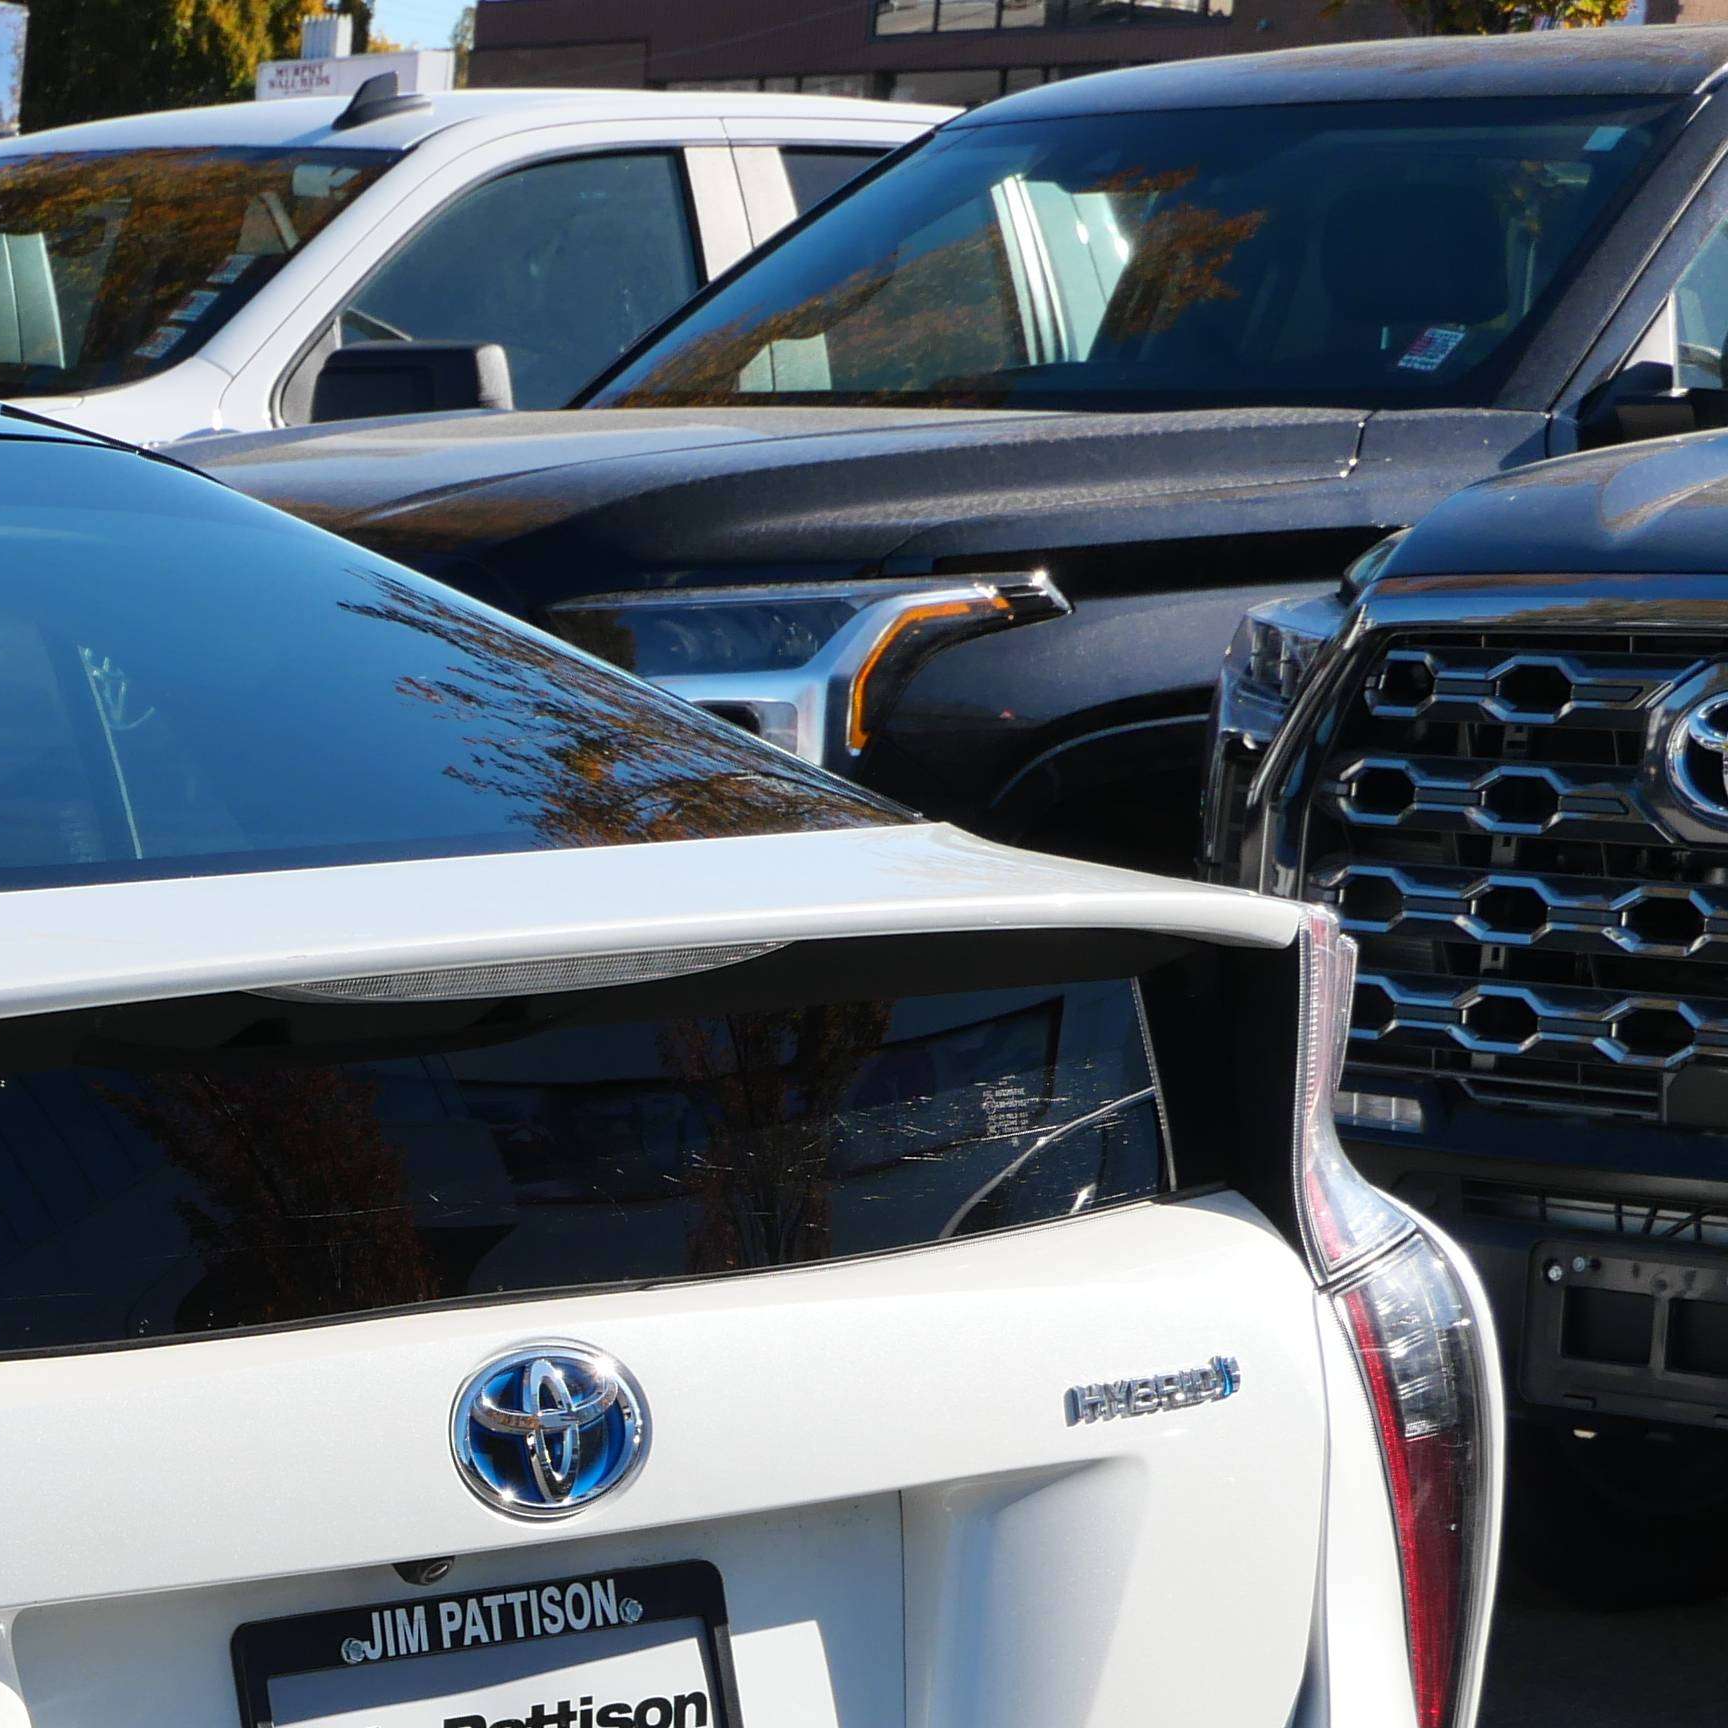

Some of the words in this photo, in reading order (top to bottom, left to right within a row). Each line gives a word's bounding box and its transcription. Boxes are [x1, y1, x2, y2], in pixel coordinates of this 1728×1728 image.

[1064, 1366, 1221, 1428] HYBRID
[364, 1604, 429, 1661] JIM
[439, 1578, 620, 1649] PATTISON
